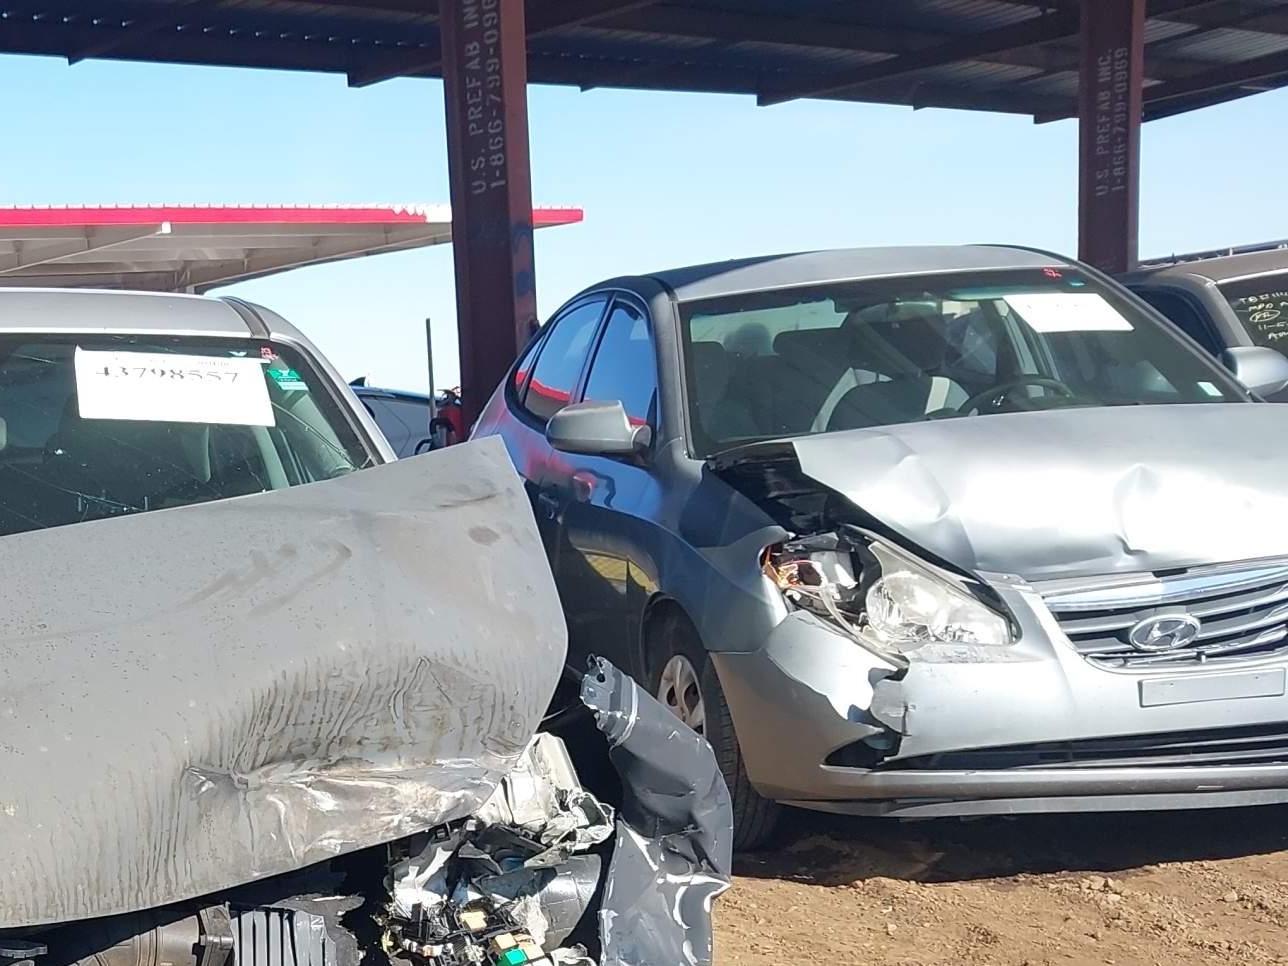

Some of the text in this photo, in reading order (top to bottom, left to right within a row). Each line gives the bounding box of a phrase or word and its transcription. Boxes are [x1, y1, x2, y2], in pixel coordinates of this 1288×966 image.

[464, 41, 484, 136] PREFAB
[1095, 90, 1112, 156] PREFAB
[471, 148, 487, 195] U.S.
[95, 365, 240, 383] 43798557
